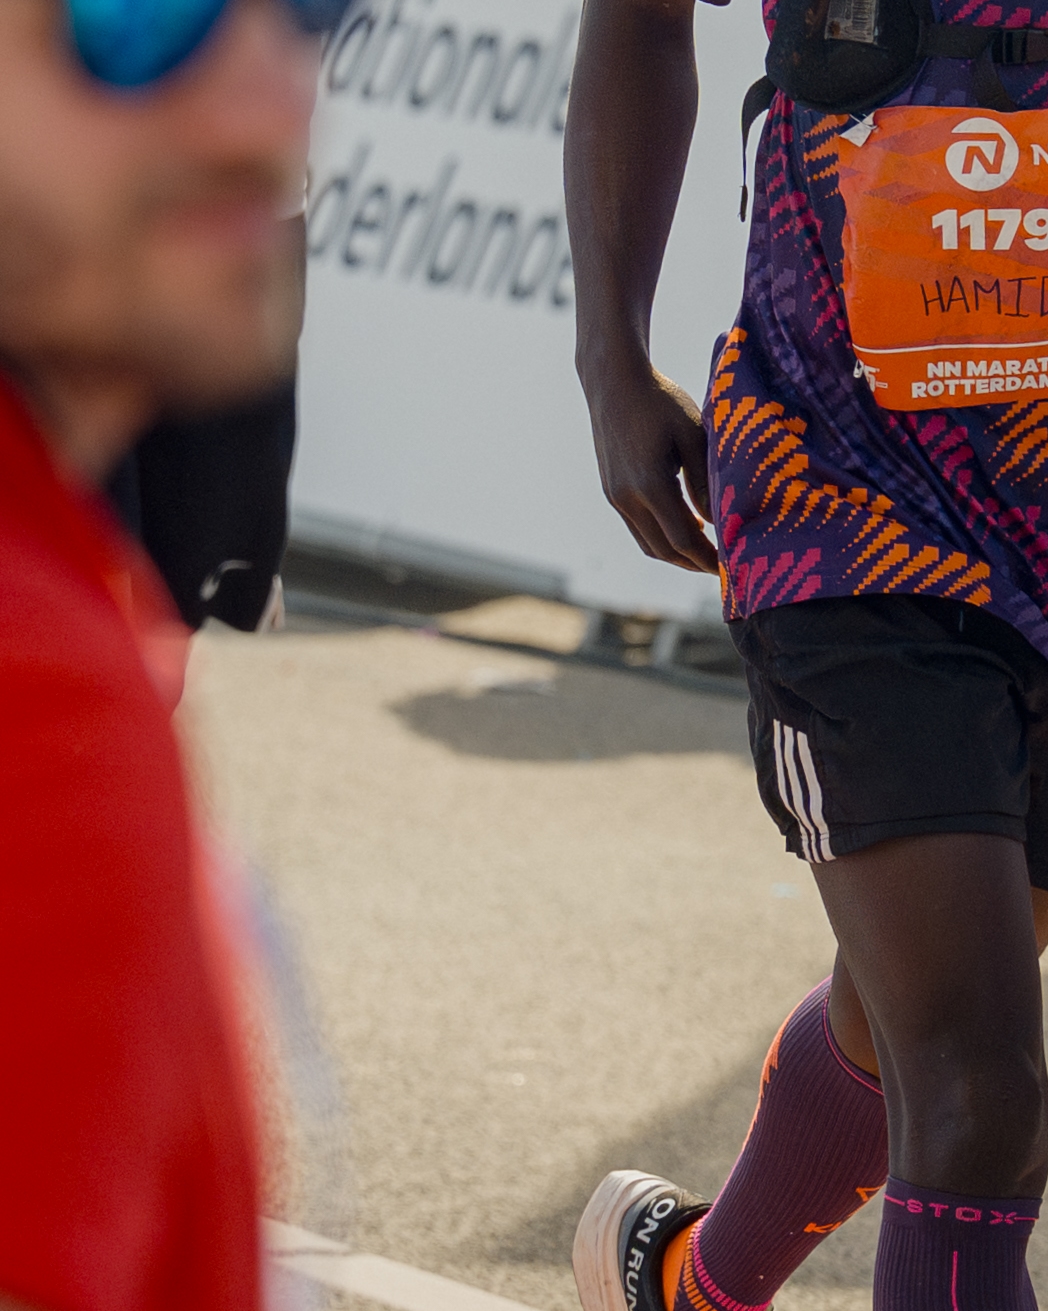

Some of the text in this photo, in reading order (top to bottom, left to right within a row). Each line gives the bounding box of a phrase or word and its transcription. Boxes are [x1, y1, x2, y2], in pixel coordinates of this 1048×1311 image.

[927, 361, 961, 378] NN
[636, 1197, 676, 1244] ON
[906, 1198, 1018, 1225] STOX
